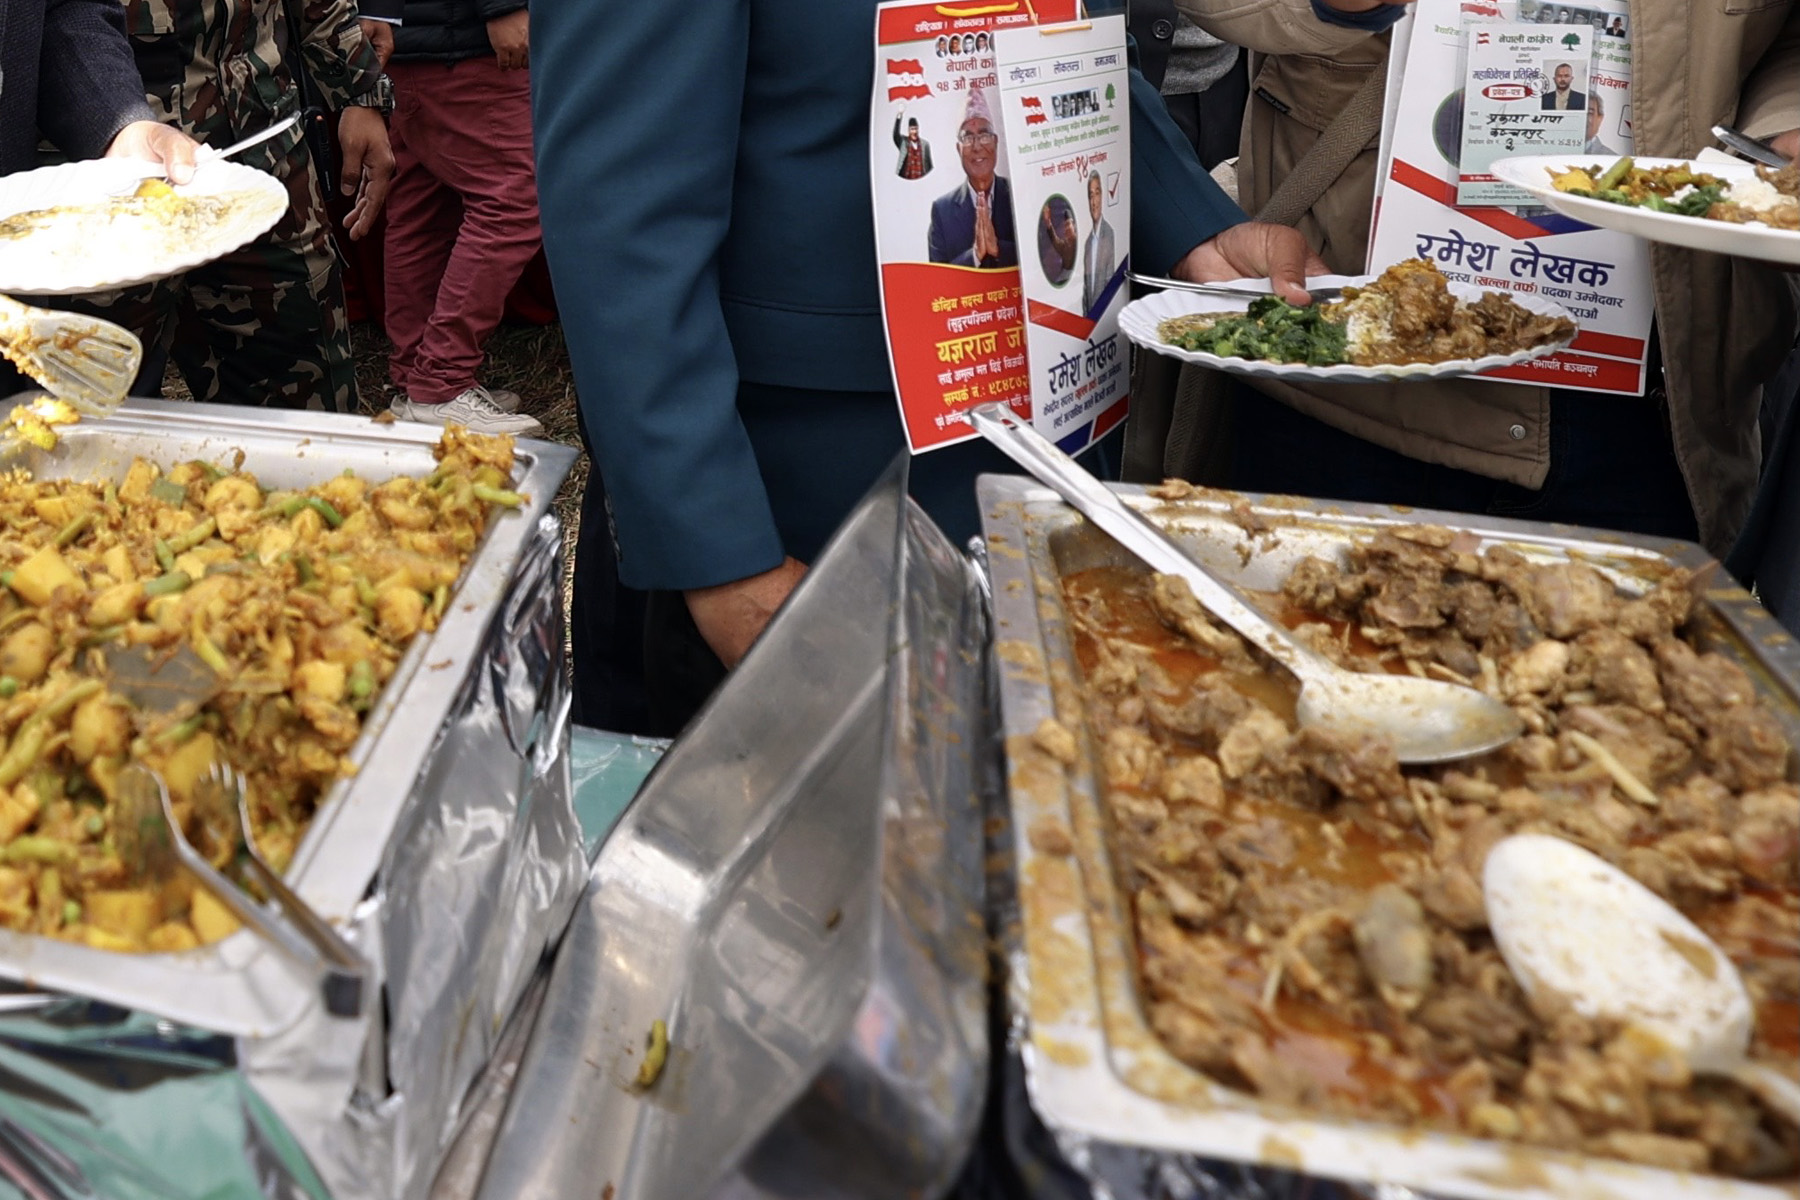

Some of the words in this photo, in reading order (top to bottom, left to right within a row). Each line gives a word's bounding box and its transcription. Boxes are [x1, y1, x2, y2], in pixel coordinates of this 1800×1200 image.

[1498, 34, 1525, 44] नेपाली
[945, 56, 978, 73] नेपाली
[1472, 67, 1510, 81] महाधिवेशन
[936, 81, 949, 92] १४
[1416, 228, 1500, 273] रमेश
[1509, 241, 1615, 288] लेखक
[1513, 280, 1539, 295] तर्फ)
[1541, 285, 1572, 301] पदका
[1574, 290, 1626, 309] उम्मेदवार
[936, 330, 998, 364] यज्ञराज
[1048, 352, 1082, 396] रमेश
[1085, 333, 1118, 378] लेखक
